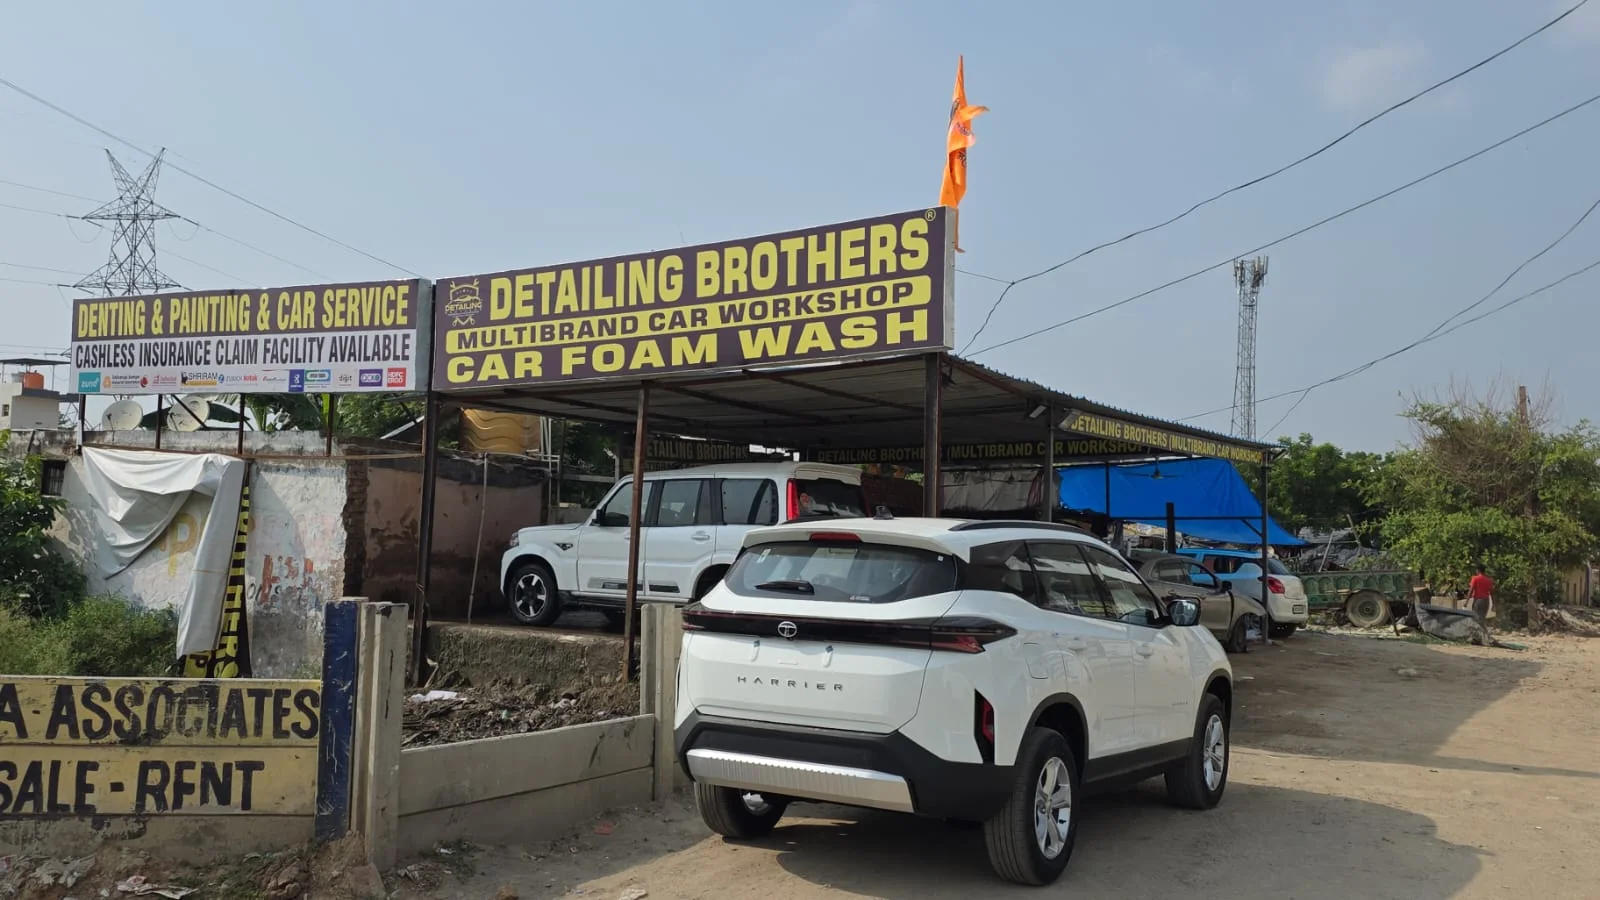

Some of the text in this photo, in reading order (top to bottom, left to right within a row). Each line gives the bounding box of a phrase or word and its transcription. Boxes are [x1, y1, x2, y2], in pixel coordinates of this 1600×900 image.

[490, 254, 684, 321] DETAILING
[696, 217, 928, 298] BROTHERS
[77, 285, 409, 338] DENTING & PAINTING & CAR SERVICE
[458, 281, 913, 349] MULTIBRAND CAR WORKSHOP
[75, 333, 411, 370] CASHLESS INSURANCE CLAIM FACILITY AVAILABLE
[447, 309, 928, 384] CAR FOAM WASH
[646, 440, 694, 459] ETAILING
[818, 449, 877, 462] DETAILING
[1037, 440, 1064, 456] CR
[1123, 424, 1168, 447] BROTHERS
[737, 675, 844, 692] HARRIER
